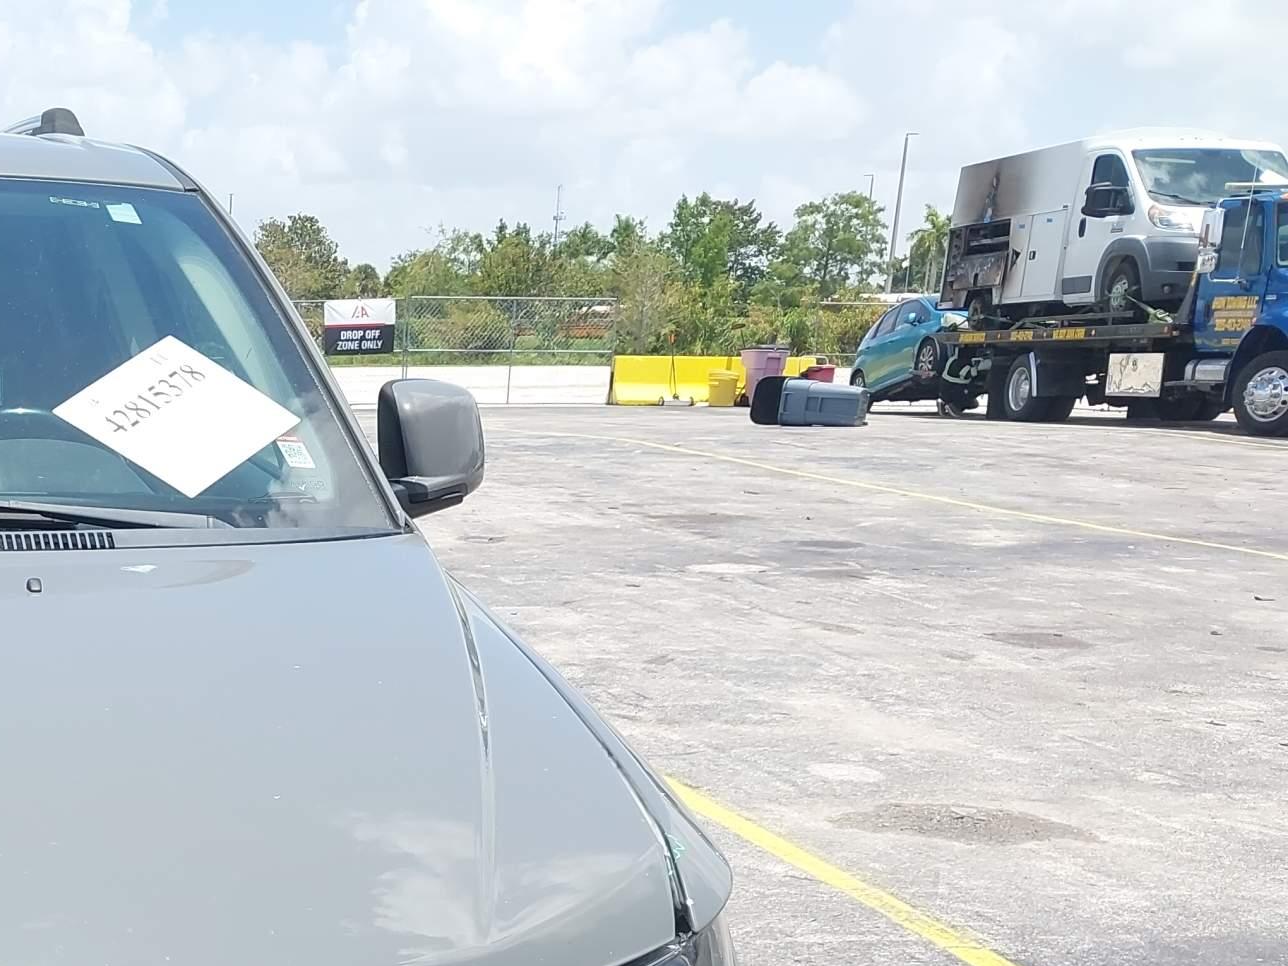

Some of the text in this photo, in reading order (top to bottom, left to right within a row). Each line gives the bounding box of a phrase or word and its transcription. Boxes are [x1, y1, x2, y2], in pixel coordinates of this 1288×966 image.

[340, 329, 381, 340] DROP OFF
[336, 339, 383, 351] ZONE ONLY
[104, 364, 206, 433] 42815378
